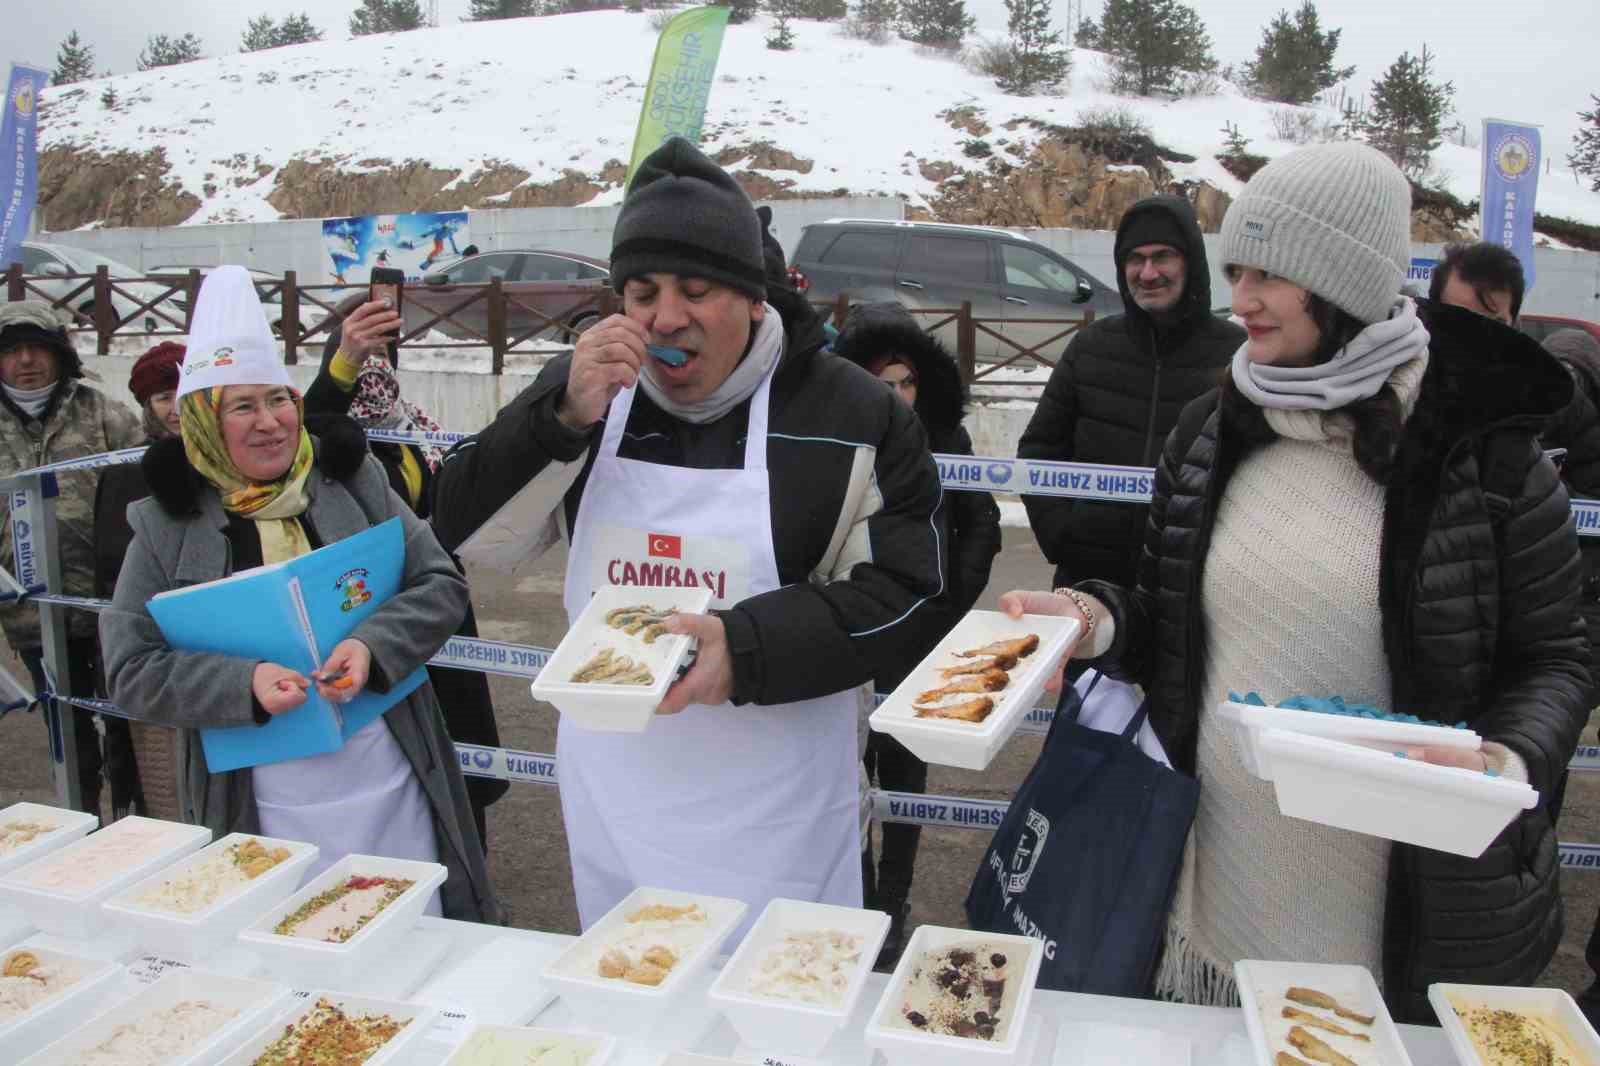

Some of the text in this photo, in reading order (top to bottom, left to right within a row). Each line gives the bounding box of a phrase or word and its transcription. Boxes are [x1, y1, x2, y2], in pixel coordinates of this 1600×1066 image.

[1029, 468, 1092, 491] ZABITA
[505, 758, 555, 778] ZABITA
[889, 801, 948, 821] ZABITA
